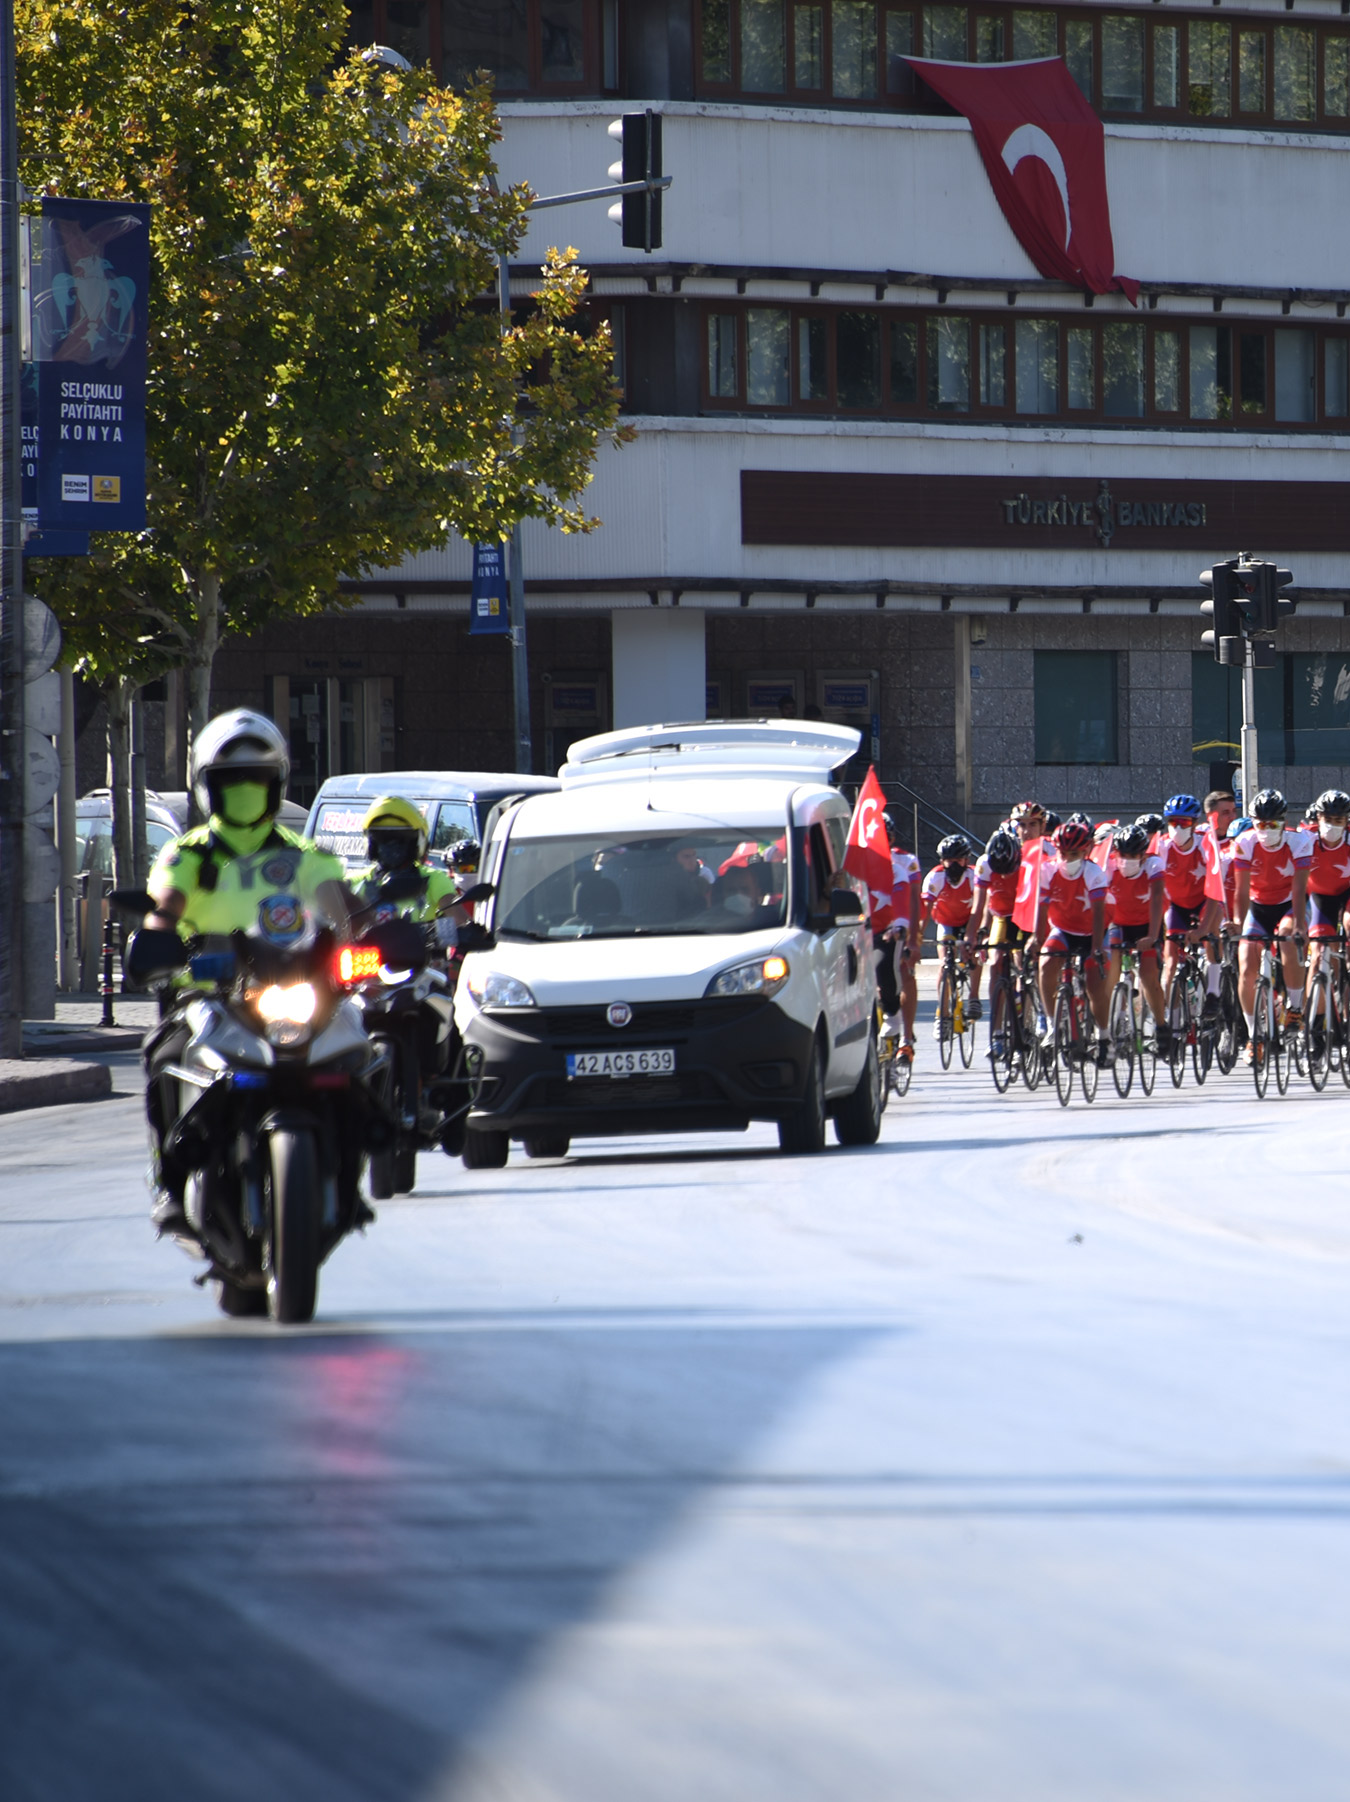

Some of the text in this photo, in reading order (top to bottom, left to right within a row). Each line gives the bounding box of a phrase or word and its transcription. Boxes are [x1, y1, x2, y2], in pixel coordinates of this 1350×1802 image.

[60, 382, 122, 401] SELÇUKLU
[60, 402, 122, 420] PAYİTAHTI
[60, 424, 122, 442] KONYA
[1003, 494, 1094, 526] TÜRKİYE
[1119, 503, 1206, 526] BANKASI
[577, 1052, 672, 1074] 42 ACS 639
